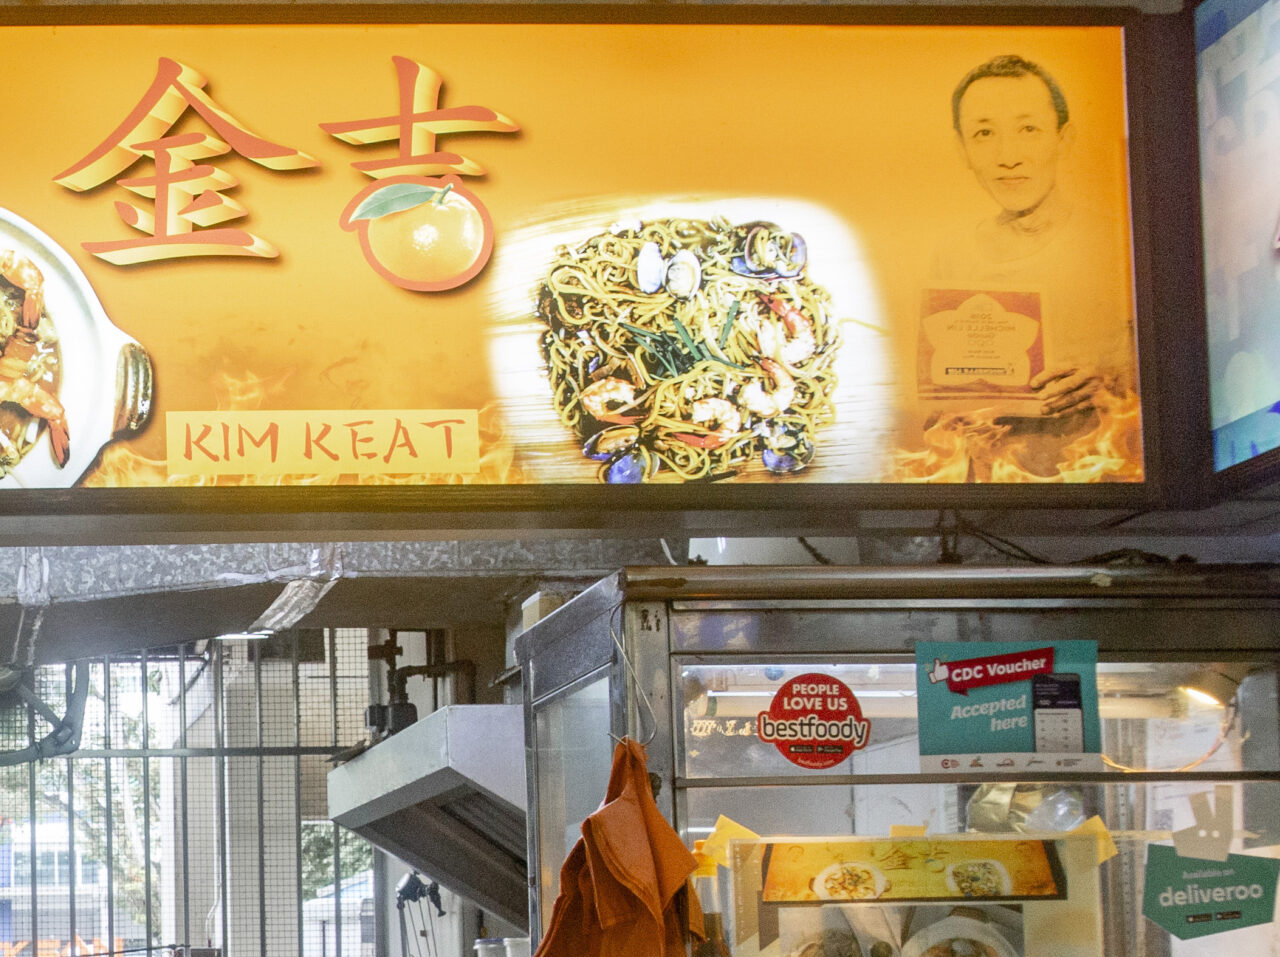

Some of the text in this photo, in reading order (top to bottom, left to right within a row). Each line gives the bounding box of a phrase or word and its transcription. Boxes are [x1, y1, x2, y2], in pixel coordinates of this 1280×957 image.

[183, 418, 465, 463] KIM KEAT
[951, 658, 1046, 682] CDC Voucher
[792, 684, 839, 694] PEOPLE
[783, 698, 848, 710] LOVE US
[950, 695, 1026, 719] Accepted
[762, 716, 866, 744] bestfoody
[990, 715, 1027, 731] here
[1160, 883, 1264, 906] deliveroo
